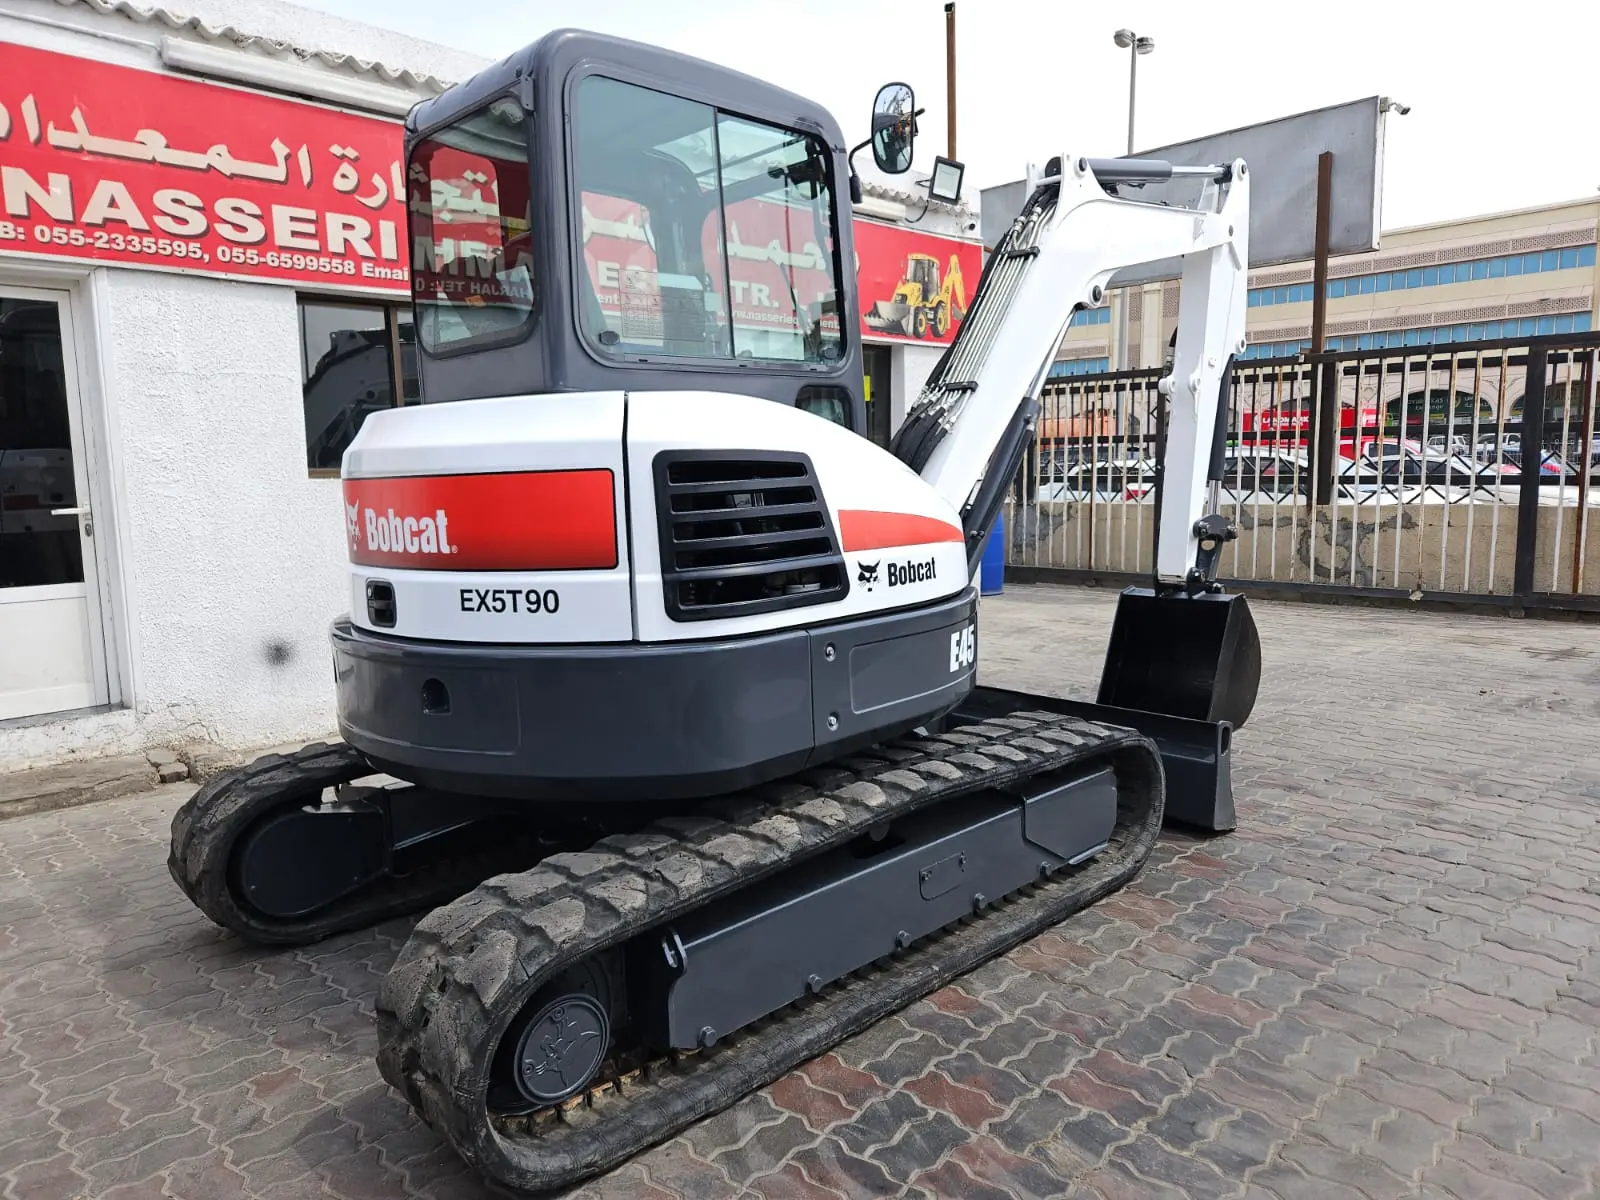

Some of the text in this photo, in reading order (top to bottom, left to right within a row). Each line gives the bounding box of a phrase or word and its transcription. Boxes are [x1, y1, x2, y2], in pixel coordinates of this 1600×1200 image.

[1, 166, 398, 260] NASSERI
[34, 225, 209, 260] 055-2335595,
[217, 246, 356, 276] 055-6599558
[361, 262, 409, 281] Emai
[887, 557, 936, 587] Bobcat
[461, 590, 560, 613] EX5T90
[949, 624, 976, 671] E45
